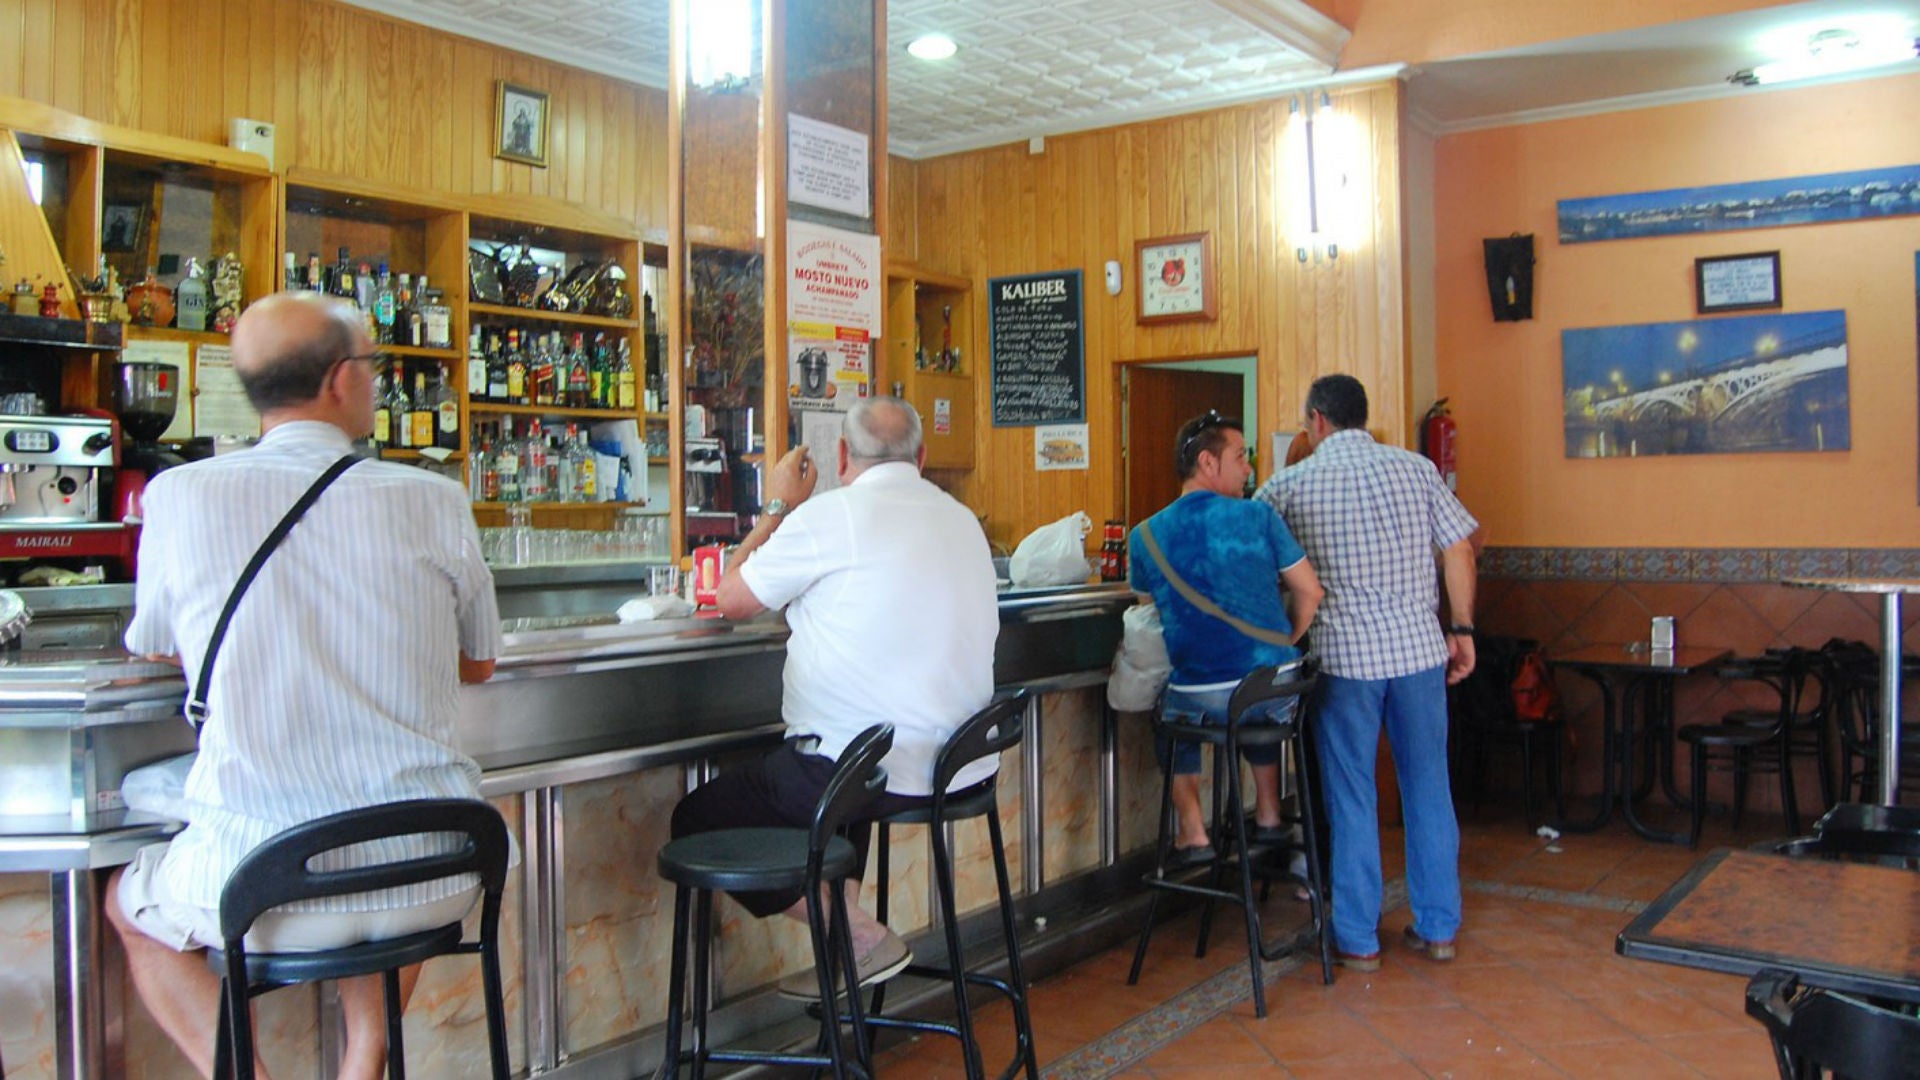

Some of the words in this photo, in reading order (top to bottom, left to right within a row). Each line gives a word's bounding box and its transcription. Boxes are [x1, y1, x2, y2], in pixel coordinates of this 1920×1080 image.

[794, 268, 832, 284] MOSTO
[834, 274, 869, 290] NUEVO
[1002, 279, 1066, 300] KALIBER
[15, 536, 73, 548] MAIRALI
